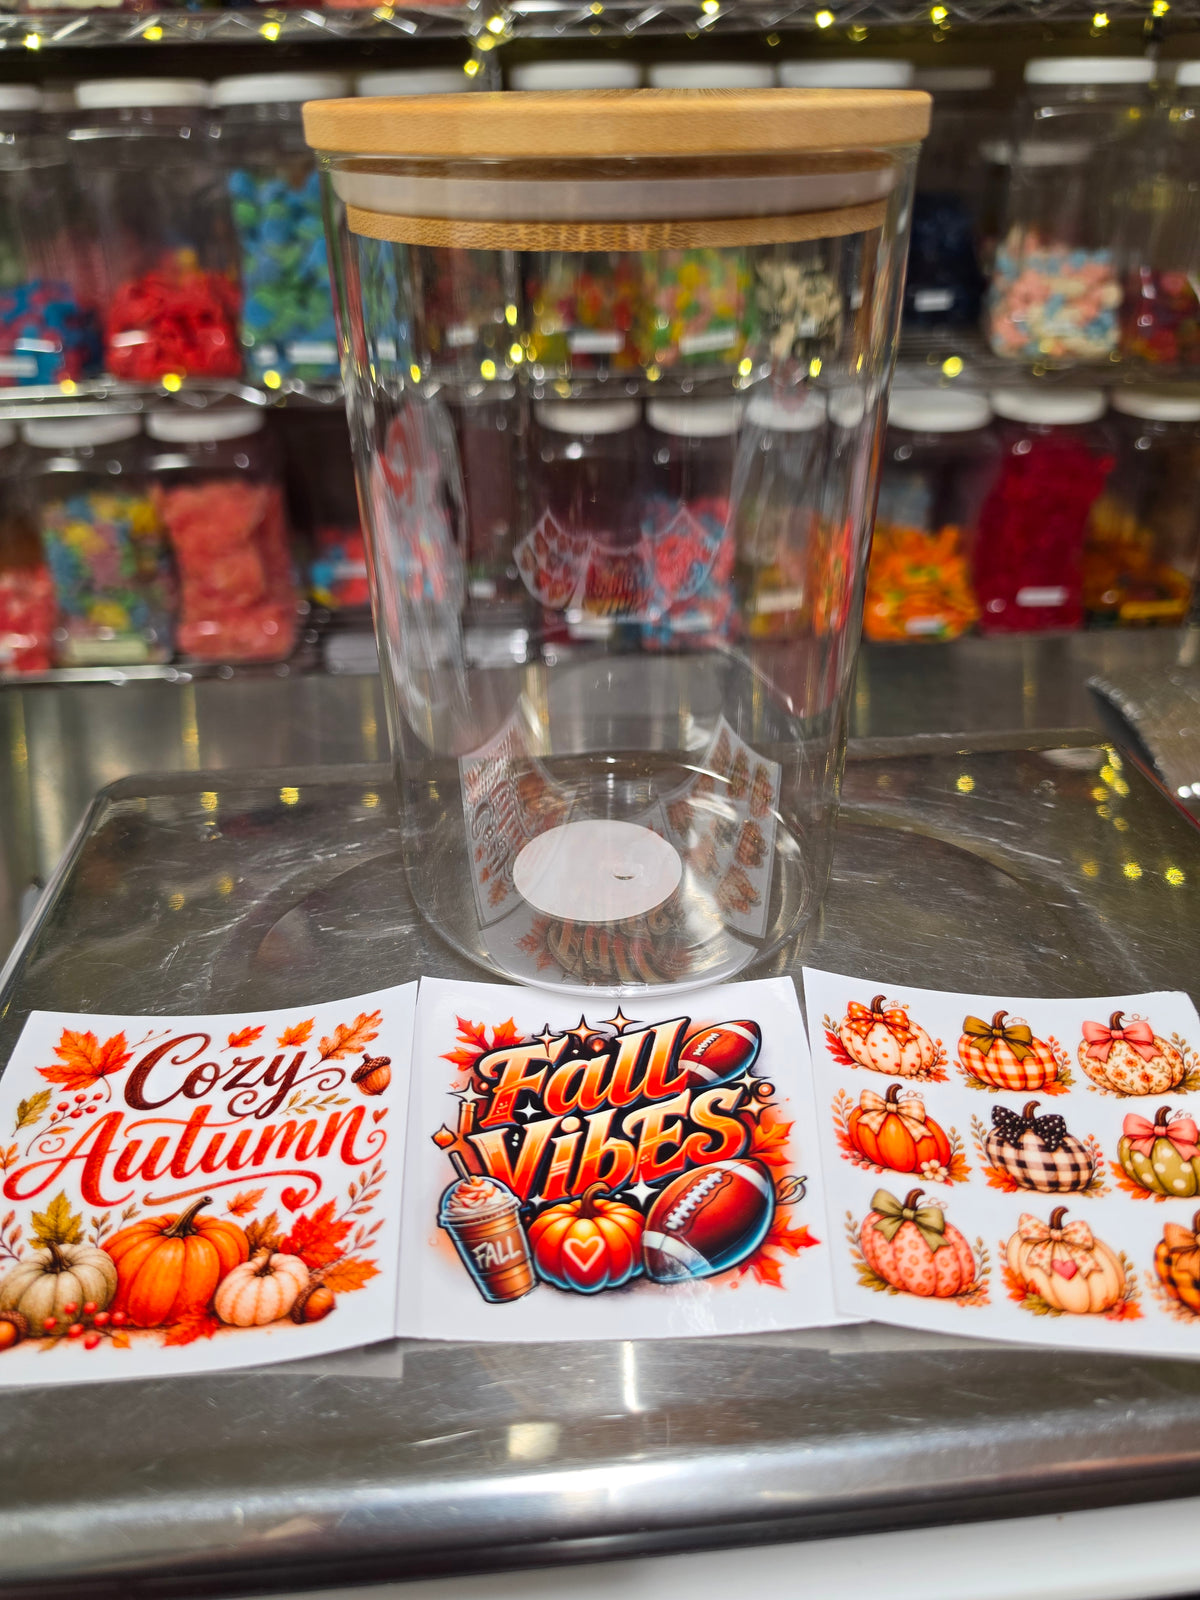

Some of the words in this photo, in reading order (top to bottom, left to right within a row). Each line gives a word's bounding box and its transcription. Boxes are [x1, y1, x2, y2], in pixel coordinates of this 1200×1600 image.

[124, 1032, 345, 1119] Cozy
[477, 1016, 691, 1128] Fall
[3, 1104, 387, 1207] Autumn
[471, 1235, 523, 1270] FALL
